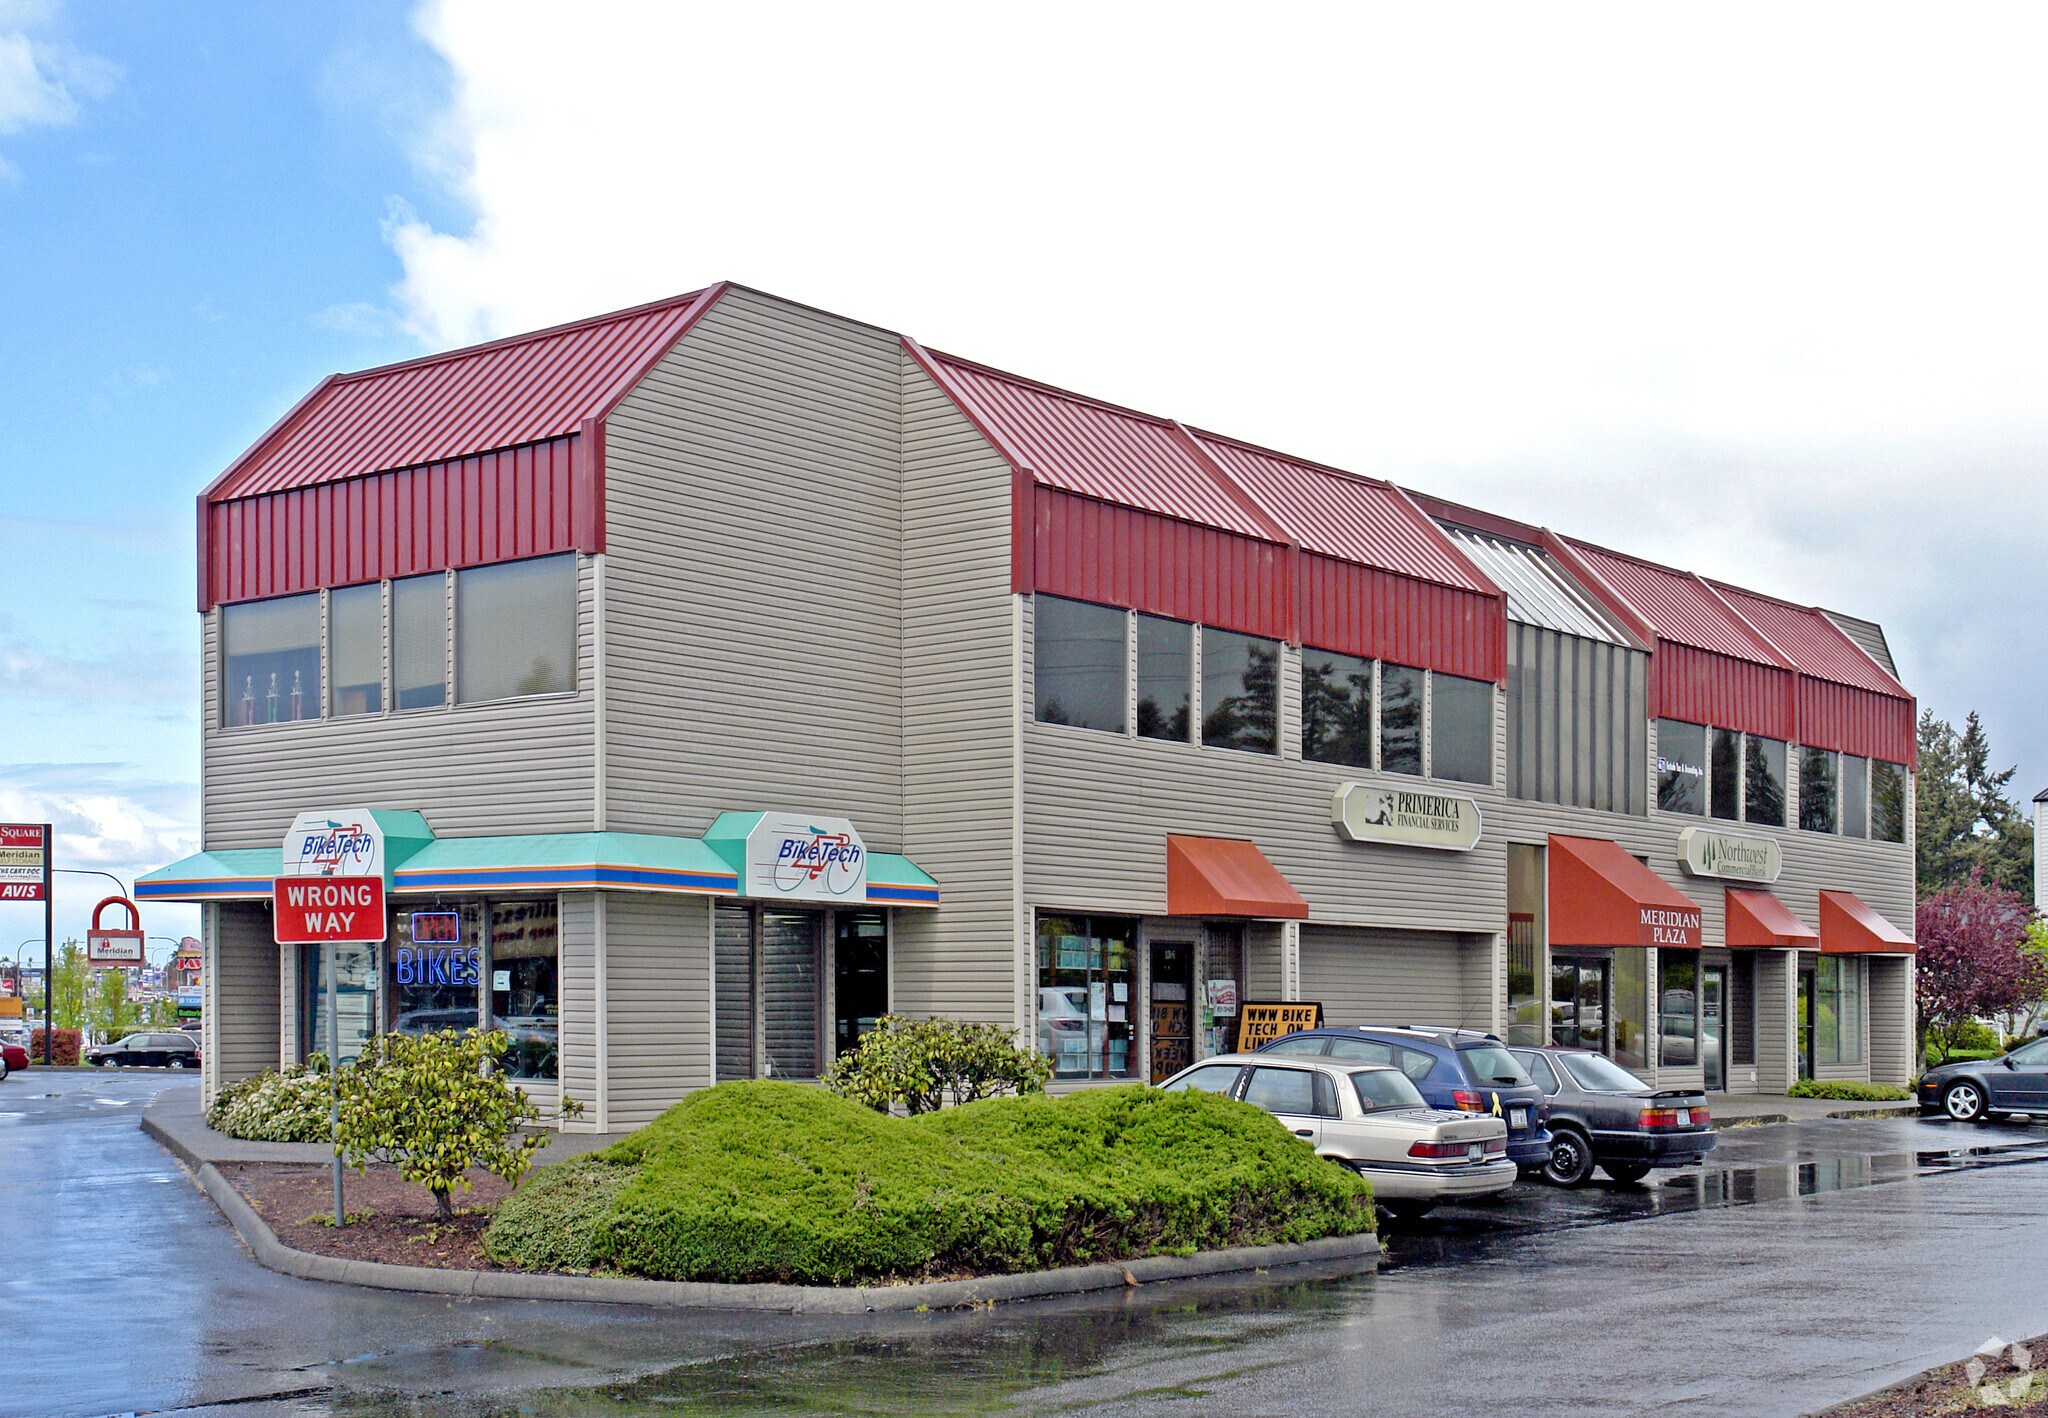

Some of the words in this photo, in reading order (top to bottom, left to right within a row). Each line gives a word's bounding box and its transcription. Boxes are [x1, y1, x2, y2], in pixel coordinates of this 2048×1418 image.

[1398, 792, 1459, 819] PRIMERICA
[1398, 814, 1430, 829] FINANCIAL
[1431, 818, 1459, 832] SERVICES
[302, 834, 371, 855] BikeTech
[778, 839, 860, 863] BikeTech
[1718, 838, 1767, 864] Northwest
[1, 885, 37, 897] AVIS
[287, 885, 372, 907] WRONG
[304, 912, 356, 933] WAY
[415, 915, 457, 939] OPEN
[1641, 909, 1699, 928] MERIDIAN
[1653, 927, 1687, 944] PLAZA
[397, 947, 479, 985] BIKES
[1247, 1008, 1278, 1021] WWW
[1282, 1009, 1312, 1022] BIKE
[1248, 1023, 1278, 1035] TECH
